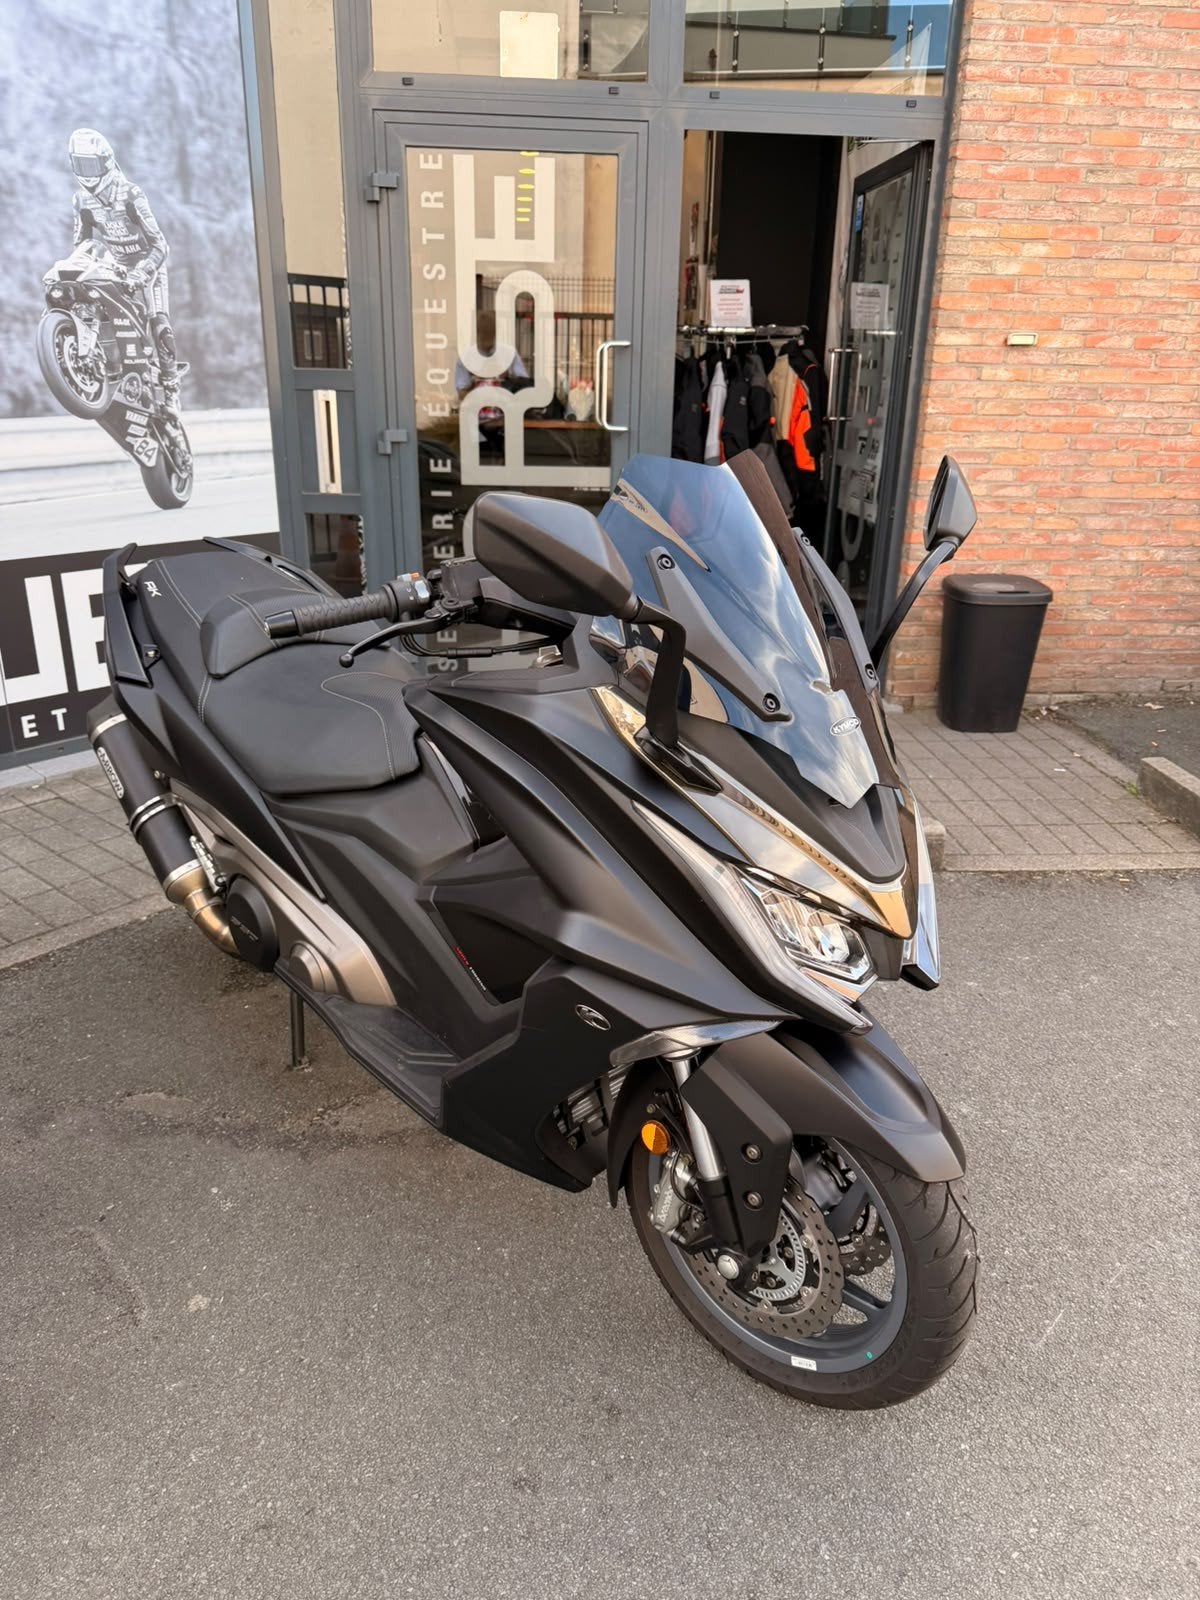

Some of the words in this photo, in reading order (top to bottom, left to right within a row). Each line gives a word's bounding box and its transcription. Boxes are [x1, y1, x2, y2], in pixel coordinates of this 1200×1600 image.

[420, 153, 448, 417] ÉQUESTRE
[453, 153, 611, 672] RSE
[430, 458, 458, 671] SEERIE
[20, 708, 68, 738] ET
